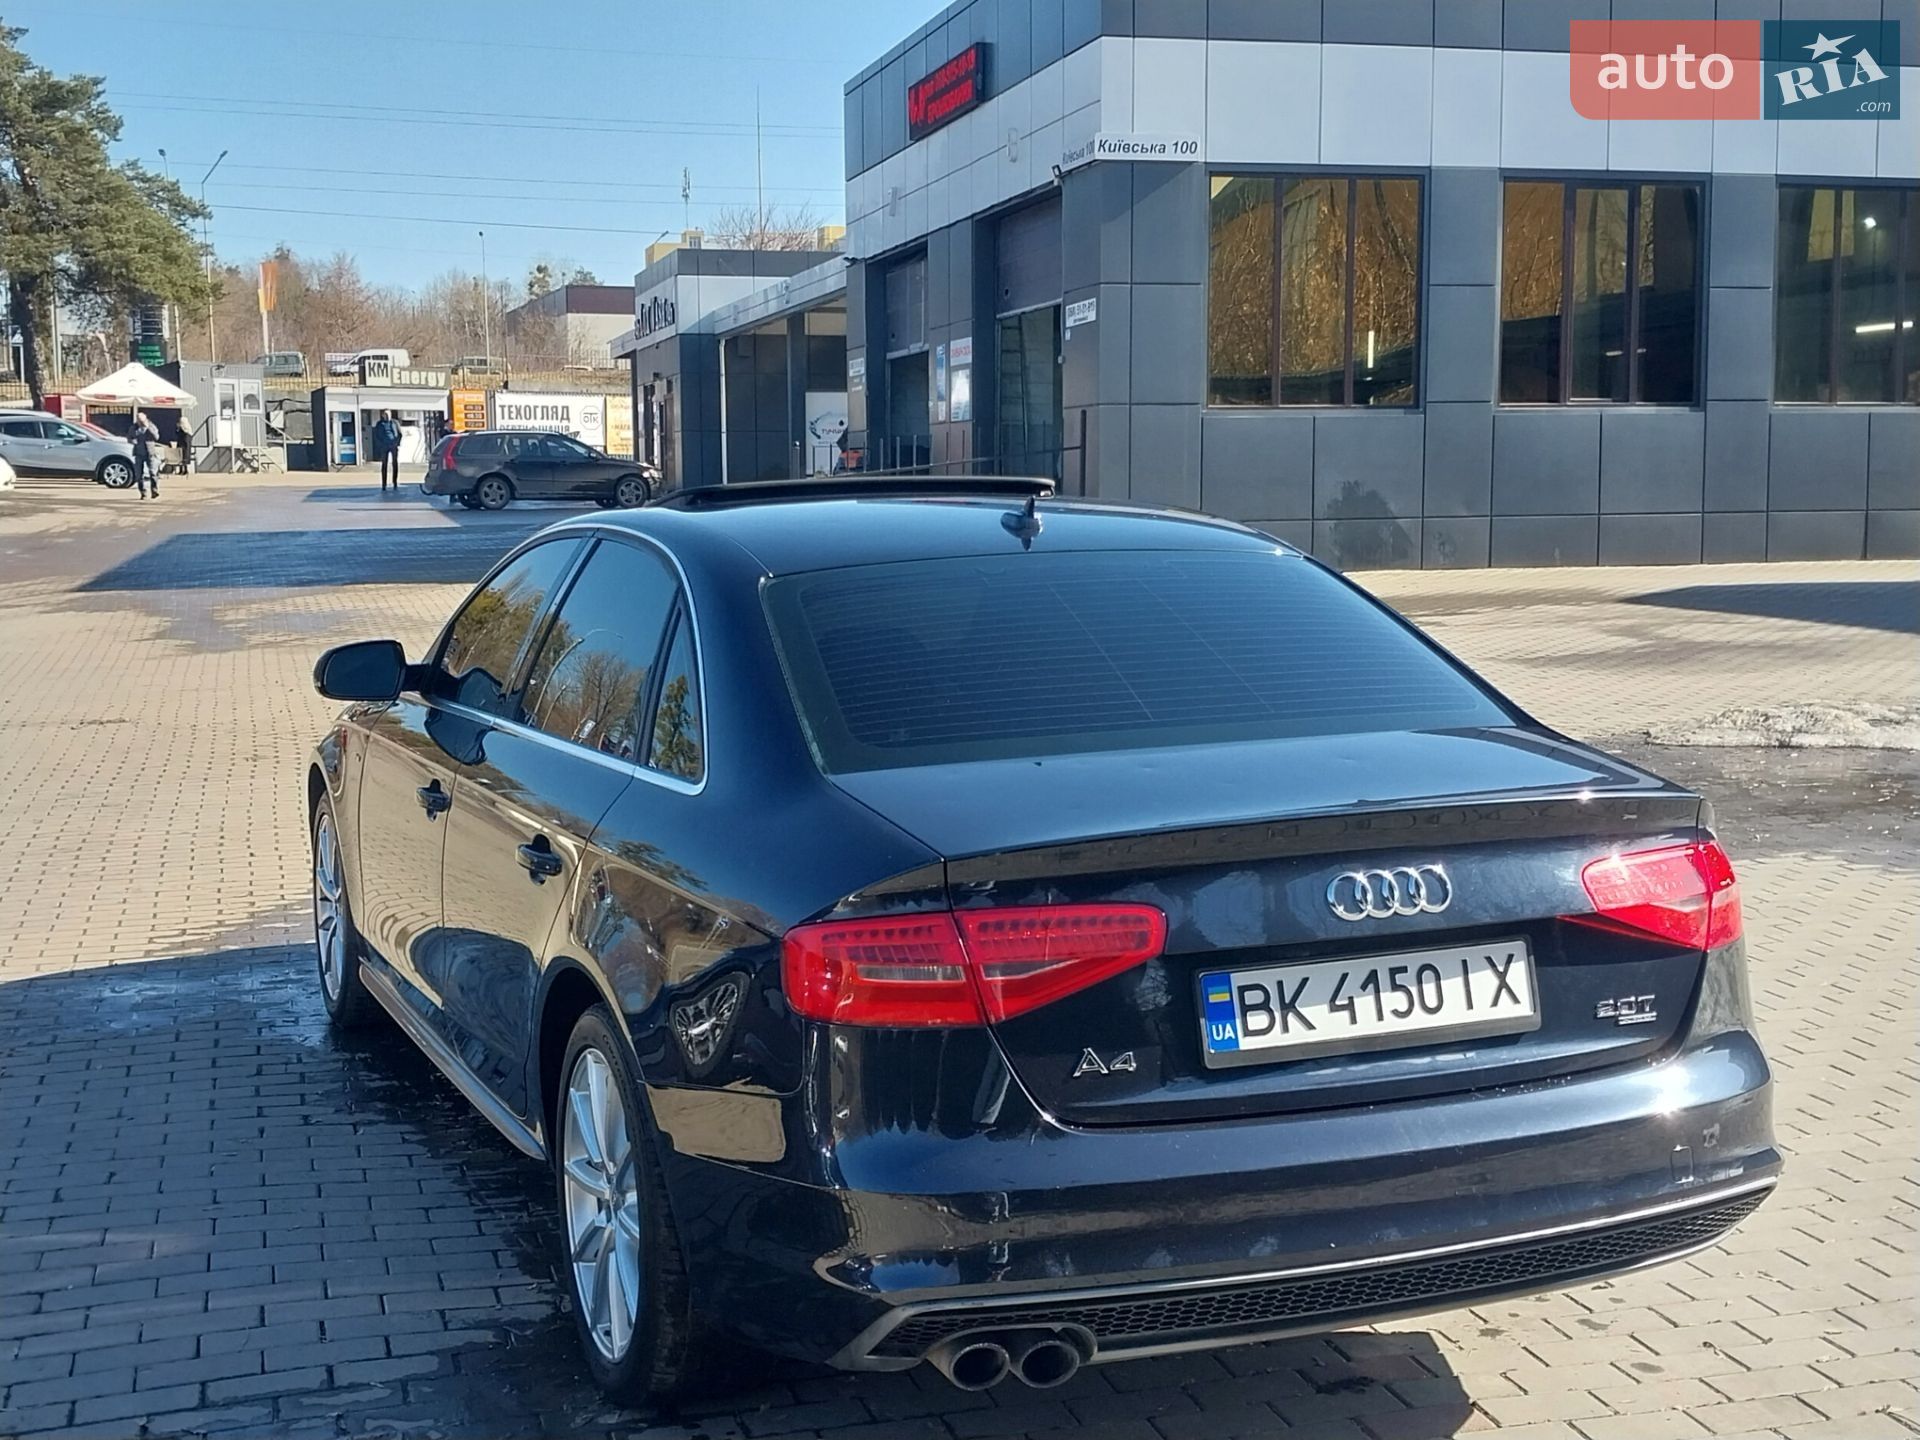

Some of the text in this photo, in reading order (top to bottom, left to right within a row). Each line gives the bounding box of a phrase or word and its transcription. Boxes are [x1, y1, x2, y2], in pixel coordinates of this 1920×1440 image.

[1097, 139, 1198, 154] Київська 100
[368, 362, 389, 378] KM
[392, 368, 445, 387] Energy
[499, 404, 571, 423] ТЕХОГЛЯД
[1237, 953, 1521, 1038] BK 4150 IX
[1212, 1022, 1236, 1041] UA
[1073, 1047, 1137, 1077] A4
